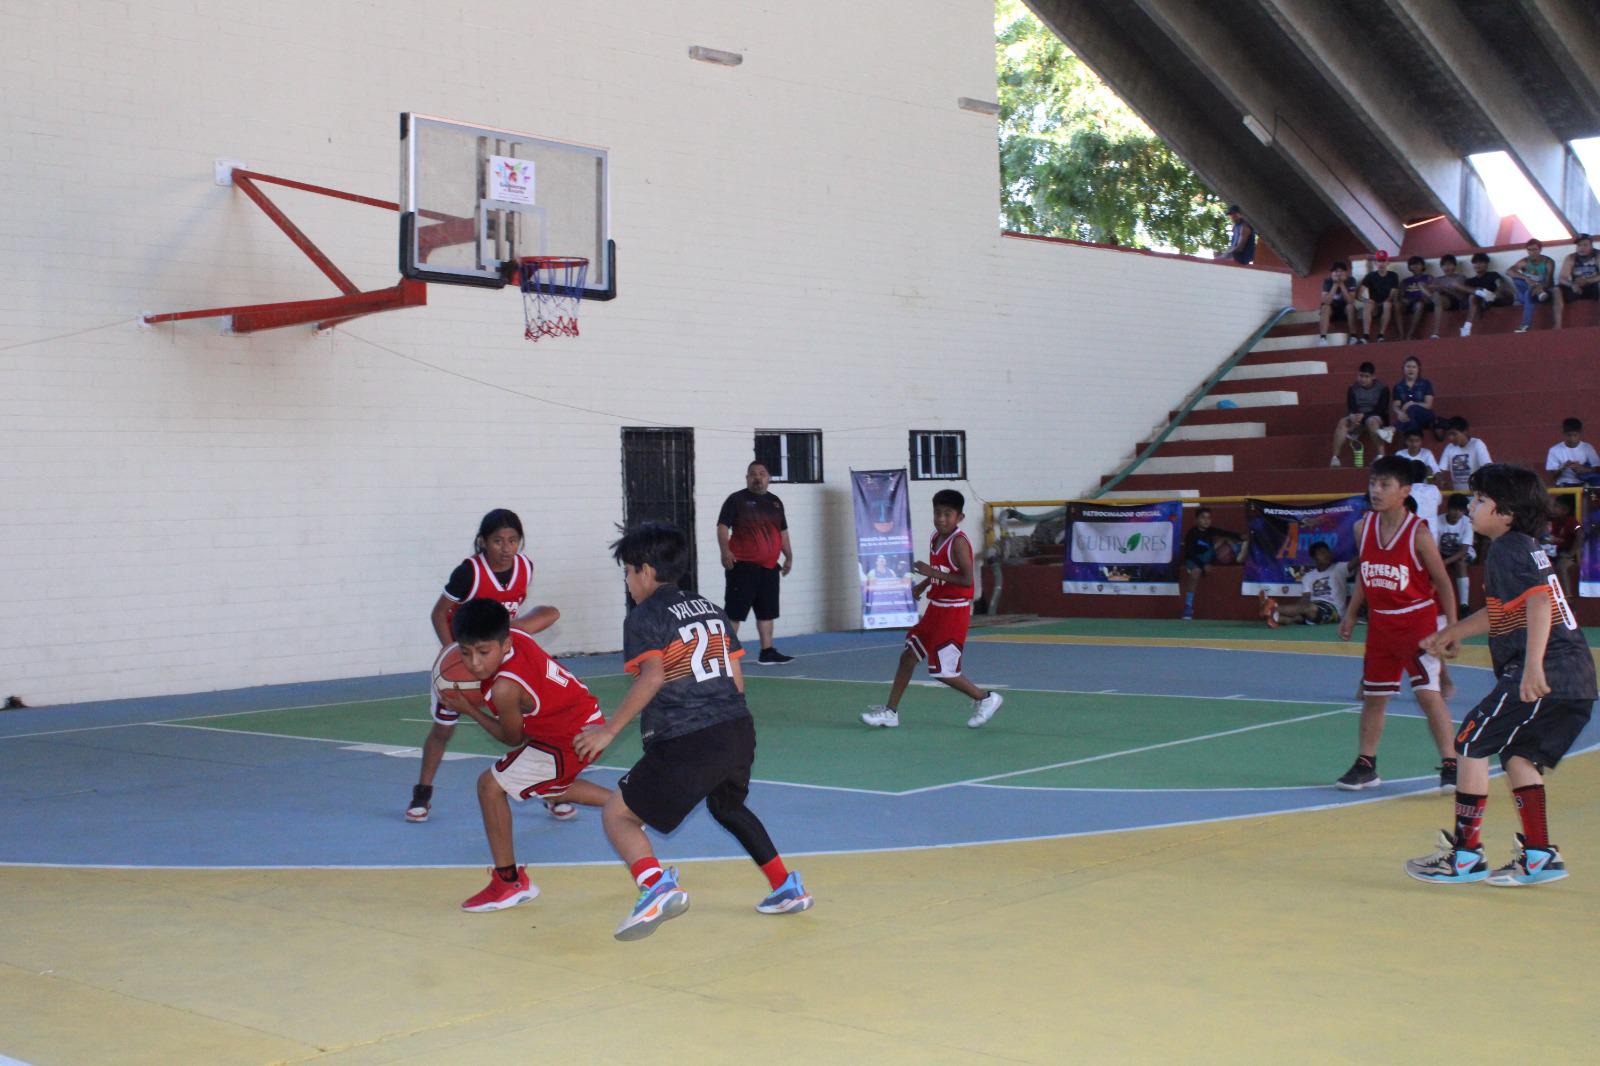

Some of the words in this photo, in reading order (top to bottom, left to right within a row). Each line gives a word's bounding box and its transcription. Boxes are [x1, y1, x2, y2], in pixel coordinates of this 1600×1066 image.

[1082, 510, 1134, 518] PATROCINADOR
[1263, 507, 1323, 516] PATROCINADOR
[678, 618, 734, 683] 27
